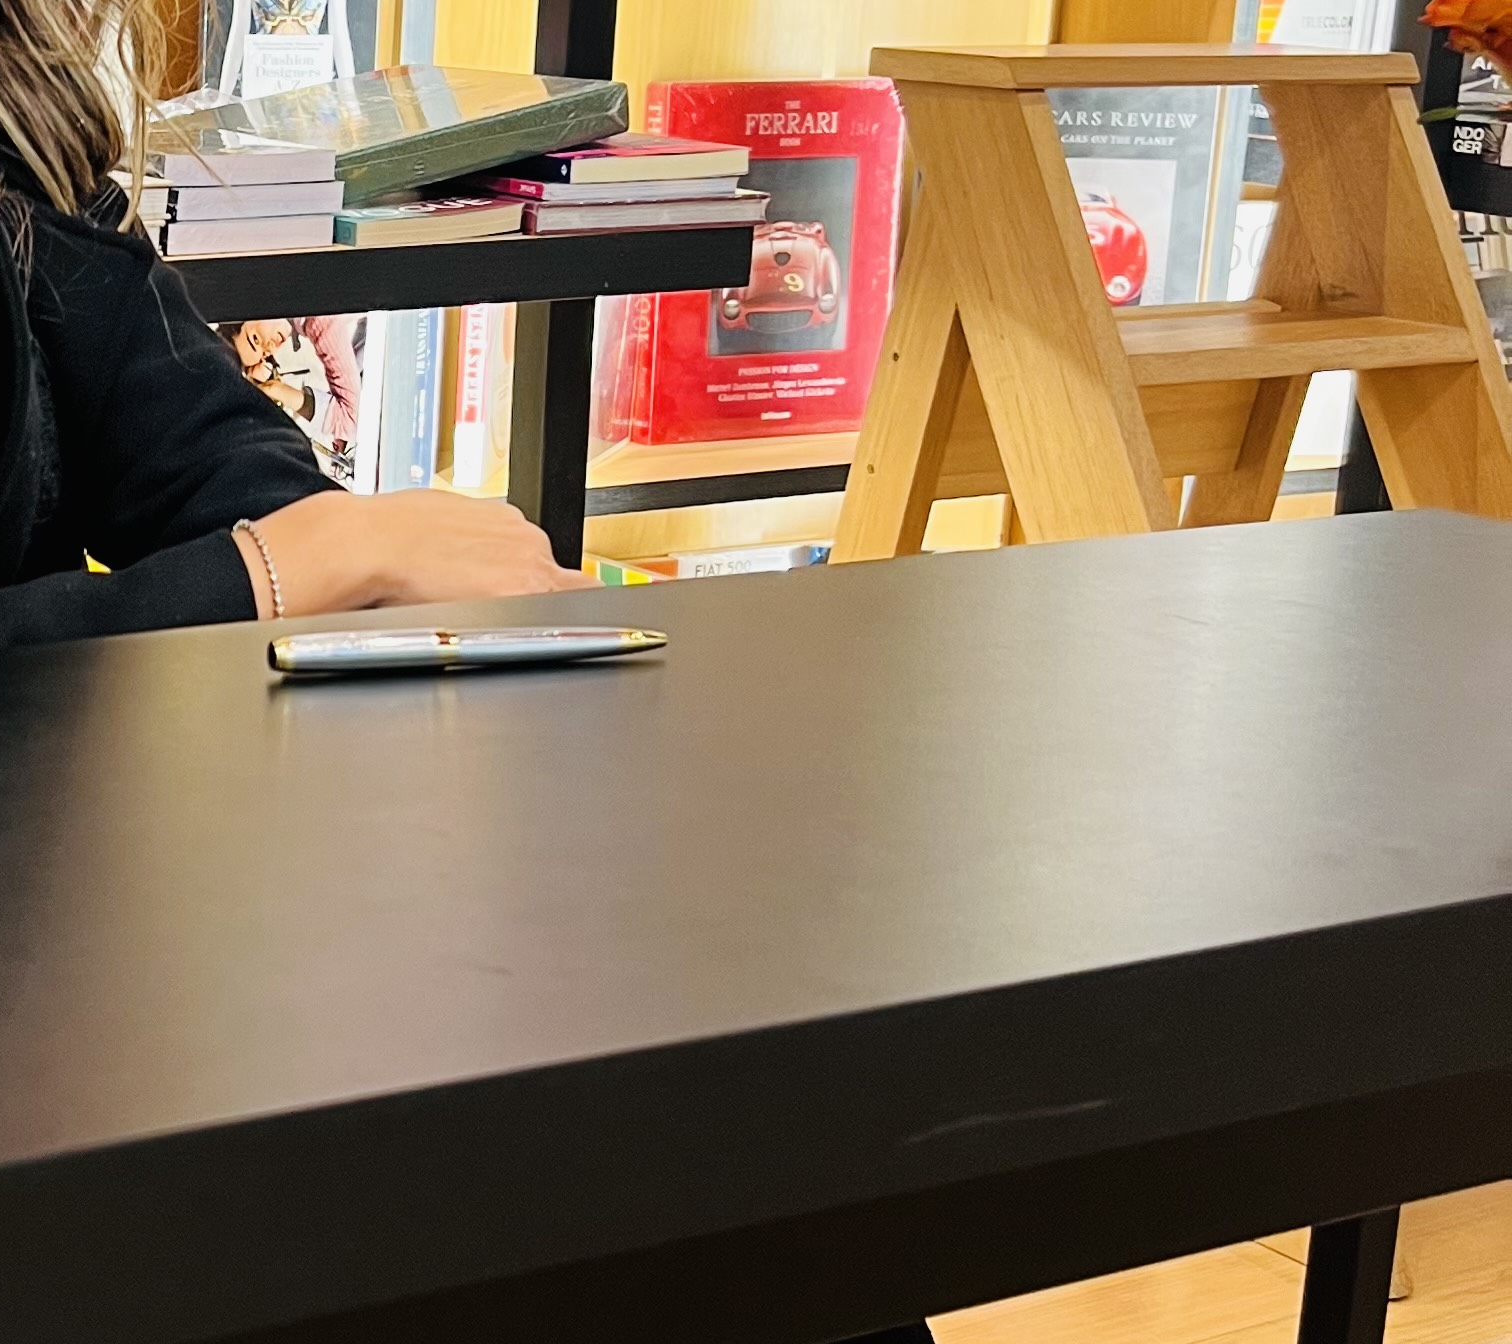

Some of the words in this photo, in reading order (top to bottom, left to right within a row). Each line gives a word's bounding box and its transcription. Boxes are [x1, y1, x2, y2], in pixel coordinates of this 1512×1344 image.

[262, 52, 316, 66] Fashion
[254, 65, 322, 83] Designers
[745, 111, 839, 136] FERRARI
[1110, 111, 1198, 130] REVIEW
[1060, 134, 1089, 144] CARS
[1090, 134, 1109, 145] ON
[1110, 135, 1132, 146] THE
[1133, 136, 1177, 147] PLANET
[1453, 126, 1485, 142] NDO
[1452, 140, 1483, 155] GER
[783, 272, 805, 293] 9
[789, 363, 819, 374] DESIGN
[694, 562, 722, 578] FIAT
[726, 559, 752, 574] 500
